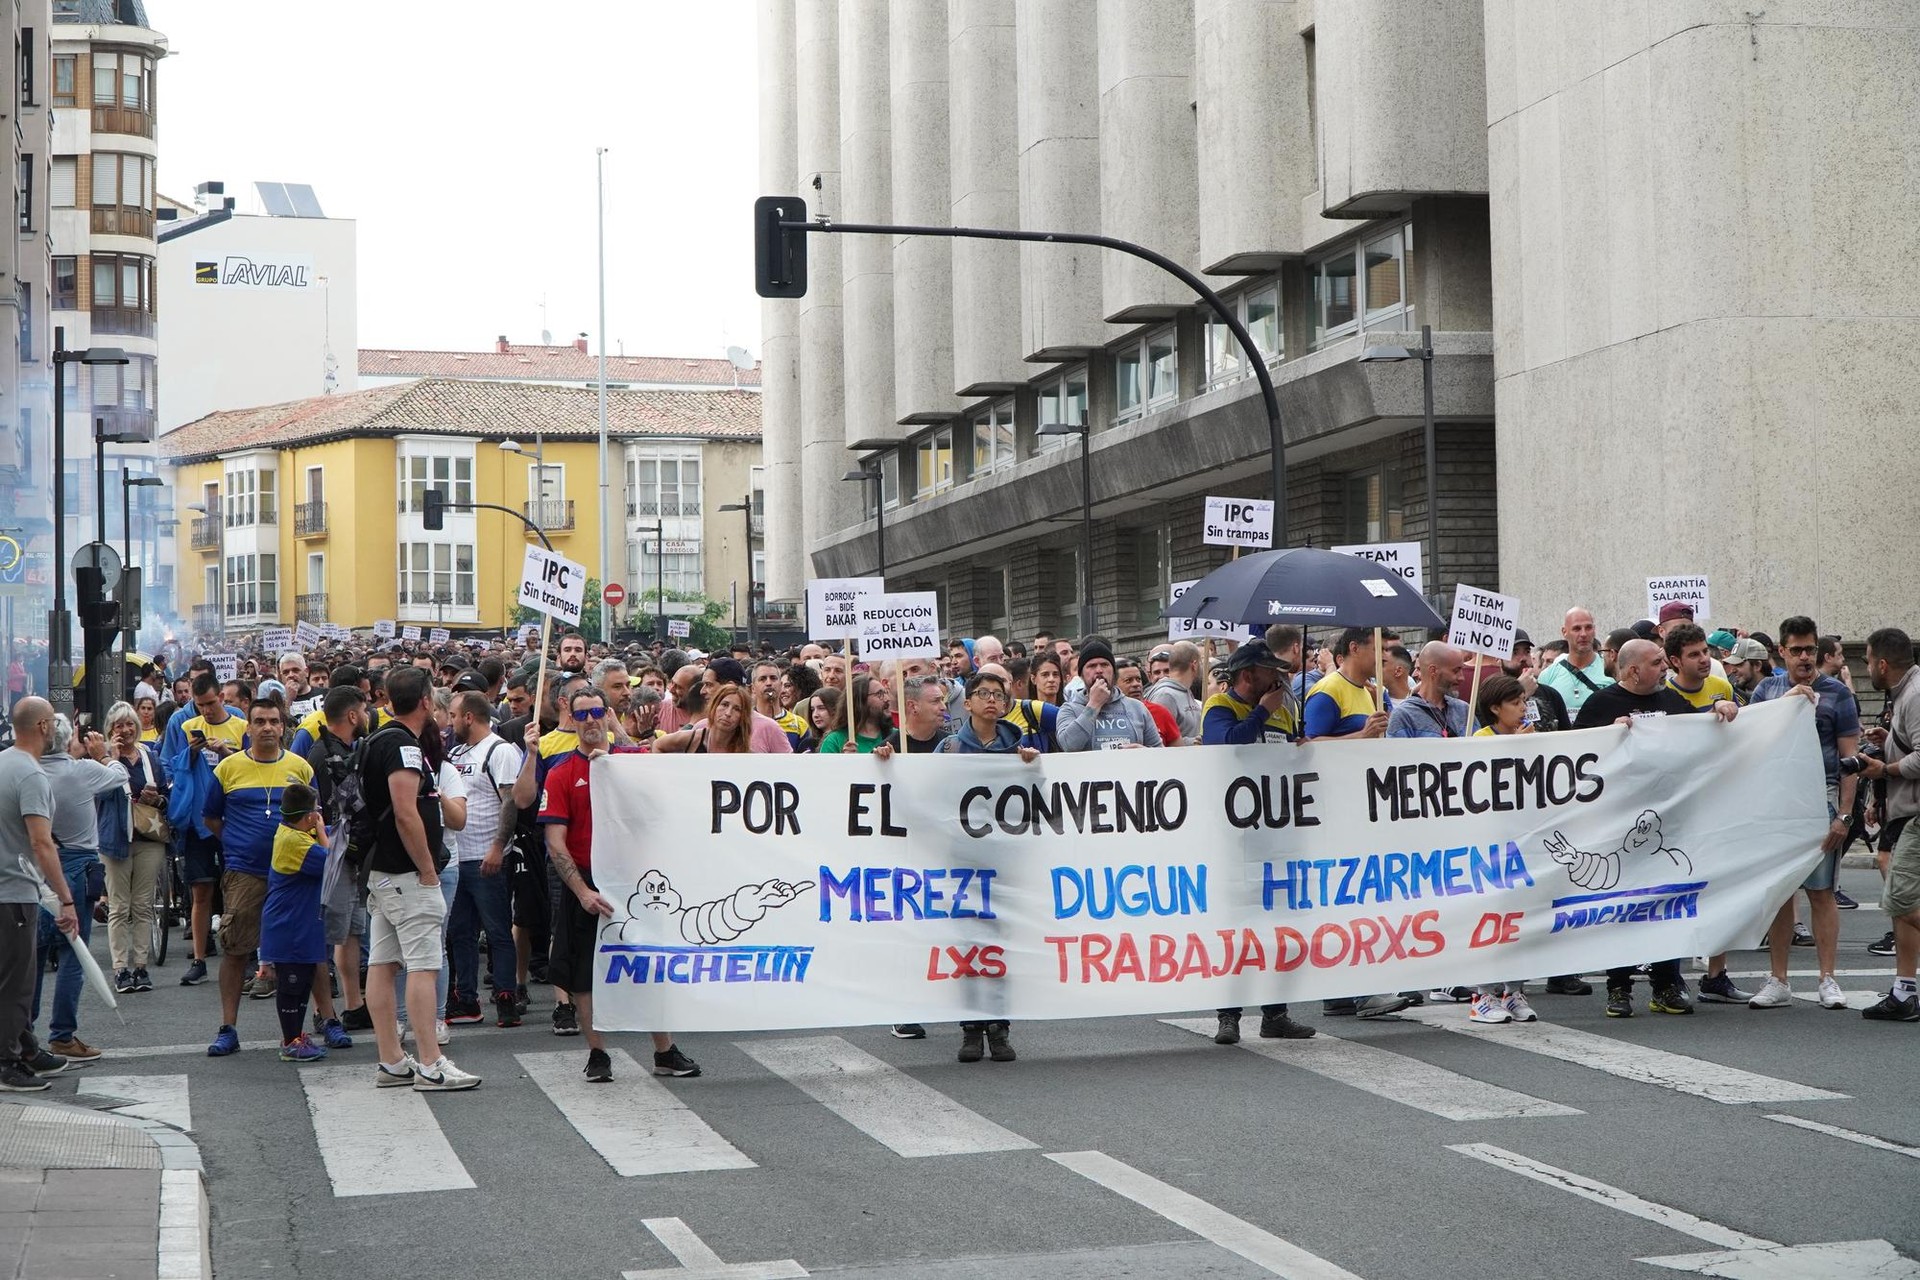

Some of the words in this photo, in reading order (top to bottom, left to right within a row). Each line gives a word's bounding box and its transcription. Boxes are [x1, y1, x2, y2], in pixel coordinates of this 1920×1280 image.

[222, 256, 307, 286] PAVIAL
[1224, 503, 1254, 524] IPC
[1207, 525, 1223, 537] Sin
[1226, 528, 1269, 543] trampas
[542, 558, 569, 589] IPC
[1649, 577, 1706, 589] GARANTÍA
[523, 581, 539, 600] Sin
[542, 590, 579, 616] trampas
[1473, 594, 1504, 611] TEAM
[1652, 591, 1705, 601] SALARIAL
[839, 602, 855, 612] BIDE
[863, 605, 932, 620] REDUCCIÓN
[882, 623, 897, 632] DE
[902, 622, 916, 632] LA
[1458, 608, 1513, 631] BUILDING
[866, 636, 933, 653] JORNADA
[1470, 631, 1493, 648] NO
[1096, 719, 1127, 729] NYC
[711, 779, 802, 835] POR
[848, 783, 907, 837] EL
[959, 778, 1188, 839] CONVENIO
[1224, 771, 1322, 831] QUE
[1366, 752, 1605, 824] MERECEMOS
[818, 865, 998, 923] MEREZI
[1050, 864, 1207, 920] DUGUN
[1261, 841, 1535, 911] HITZARMENA
[1549, 892, 1700, 935] MICHELIN
[926, 944, 1007, 981] LXS
[1044, 910, 1447, 984] TRABAJADORXS
[1468, 911, 1525, 950] DE
[604, 948, 814, 985] MICHELIN
